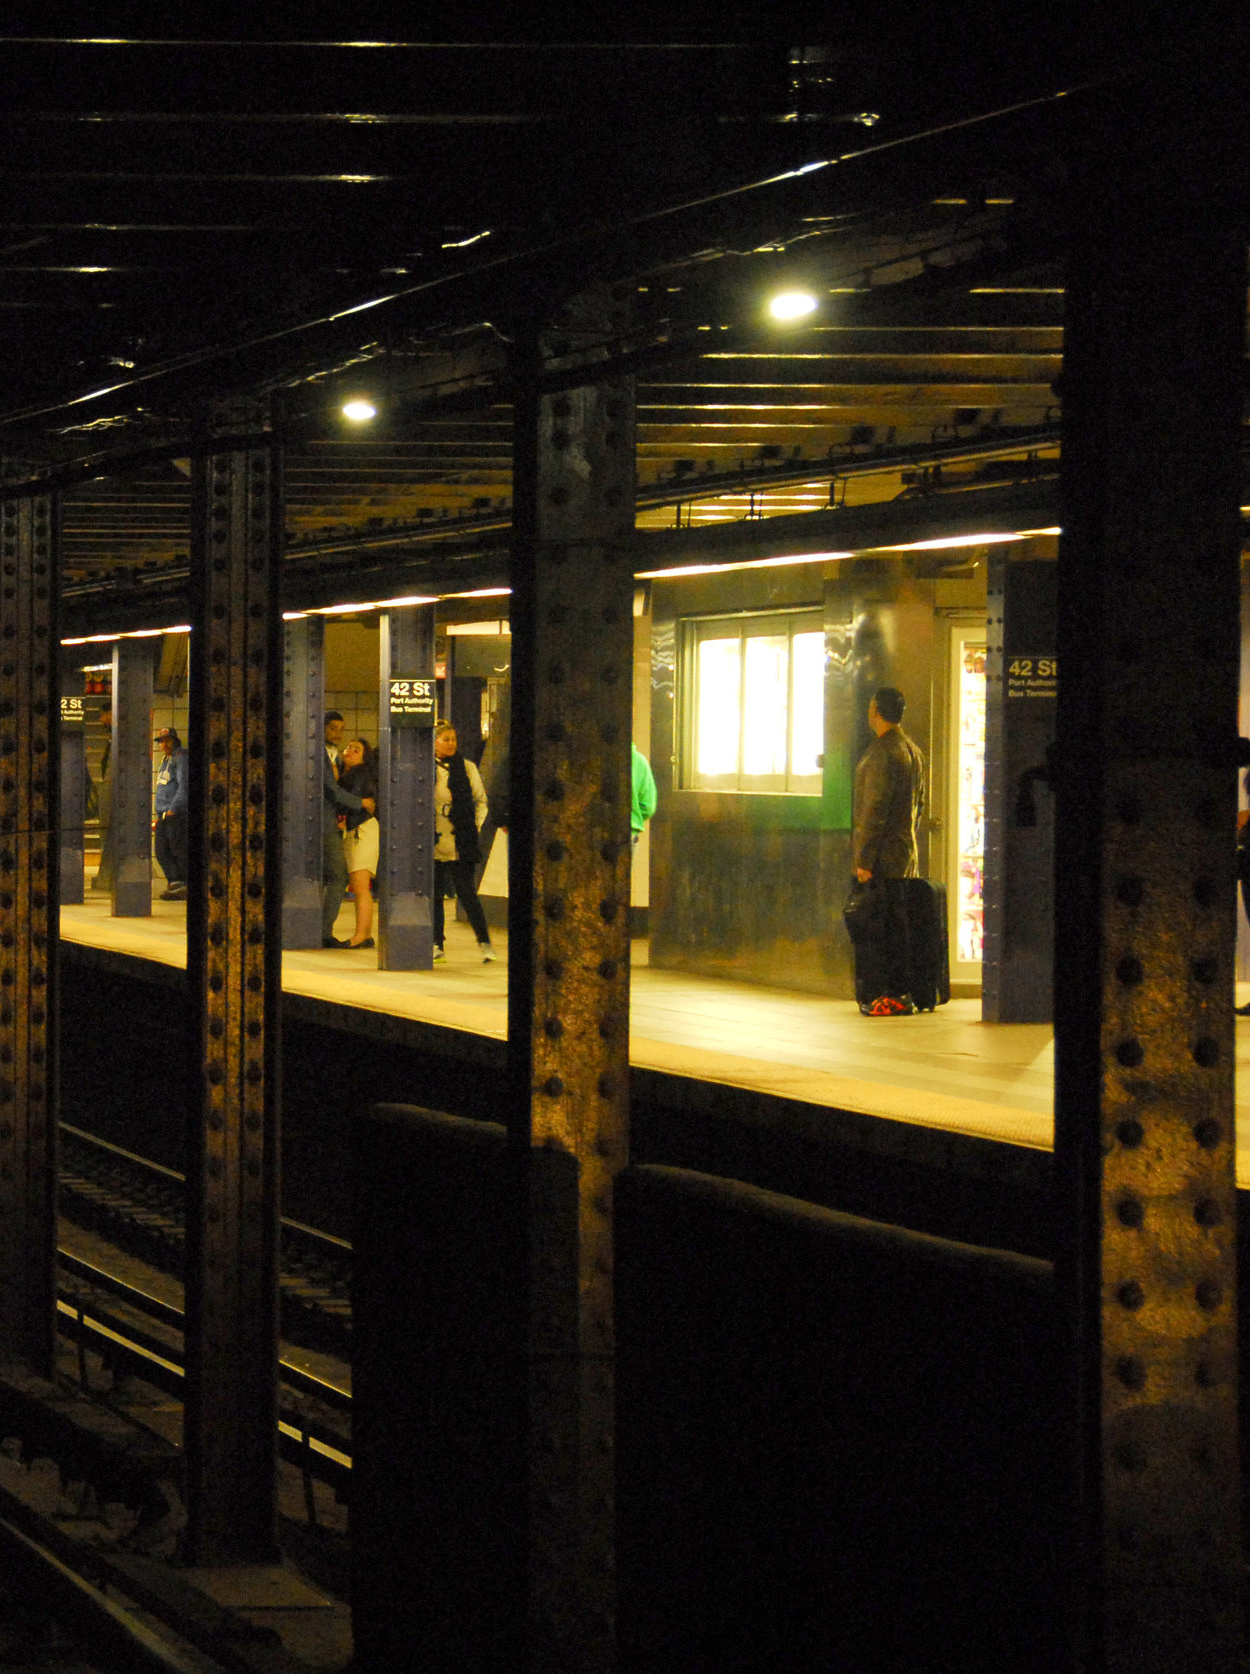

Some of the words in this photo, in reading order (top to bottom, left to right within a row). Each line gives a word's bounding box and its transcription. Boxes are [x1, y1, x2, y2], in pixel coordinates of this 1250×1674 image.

[1009, 660, 1032, 676] 42
[1038, 659, 1057, 676] St
[391, 682, 410, 696] 42
[413, 682, 430, 696] St
[61, 699, 68, 709] 2
[70, 699, 83, 709] St
